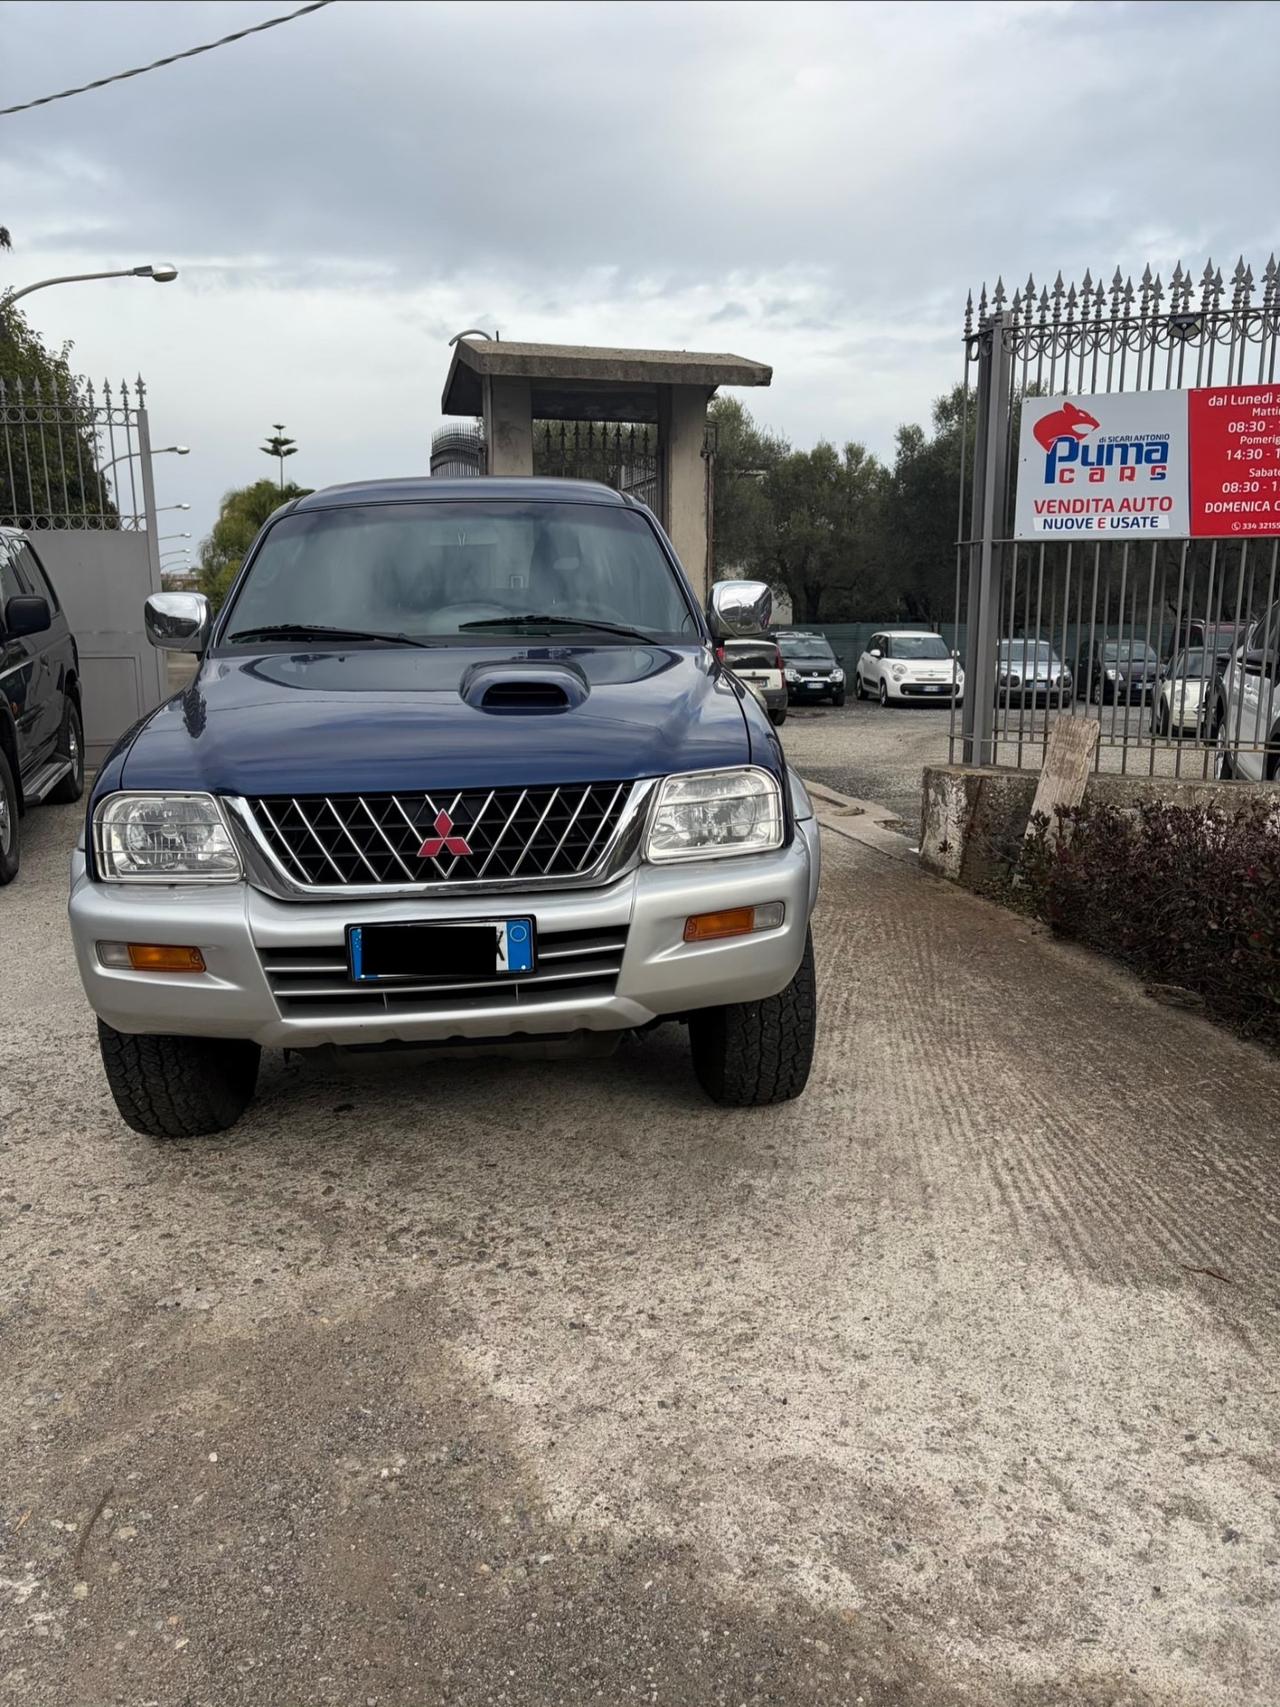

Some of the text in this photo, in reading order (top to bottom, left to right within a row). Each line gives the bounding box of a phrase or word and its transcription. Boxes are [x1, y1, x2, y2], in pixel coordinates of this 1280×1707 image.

[1208, 395, 1227, 406] dal
[1231, 392, 1273, 405] Lunedì
[1252, 407, 1280, 416] Matti
[1228, 421, 1265, 433] 08:30
[1108, 435, 1132, 443] SICARI
[1134, 433, 1170, 443] ANTONIO
[1044, 436, 1169, 484] Puma
[1226, 448, 1262, 460] 14:30
[1222, 481, 1259, 493] 08:30
[1272, 481, 1280, 491] 1
[1034, 496, 1173, 515] VENDITA AUTO
[1205, 500, 1270, 513] DOMENICA
[1043, 516, 1159, 530] NUOVE E USATE
